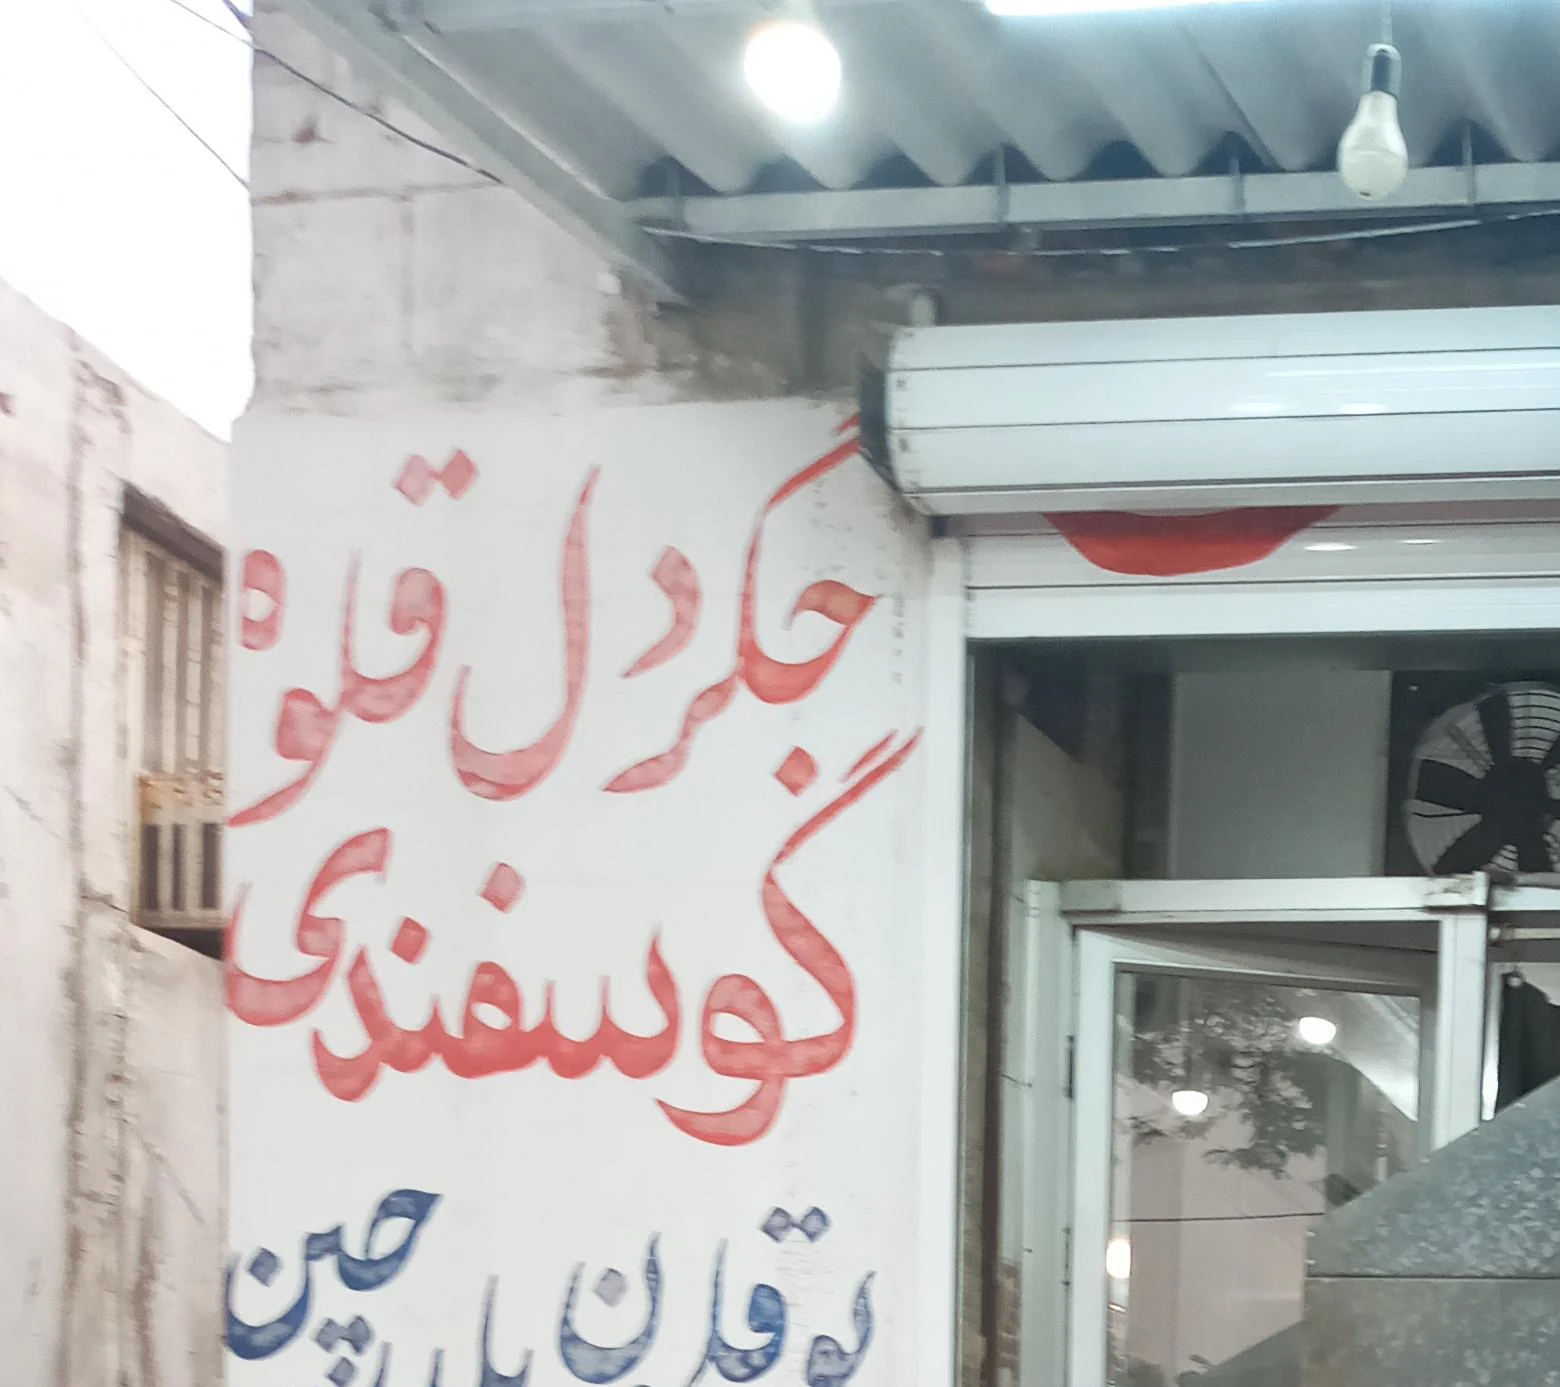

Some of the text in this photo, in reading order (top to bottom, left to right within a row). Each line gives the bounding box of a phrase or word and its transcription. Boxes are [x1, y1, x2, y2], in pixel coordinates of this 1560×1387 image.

[225, 412, 885, 829] جگر دل قلوه
[222, 724, 925, 1147] گوسفندی
